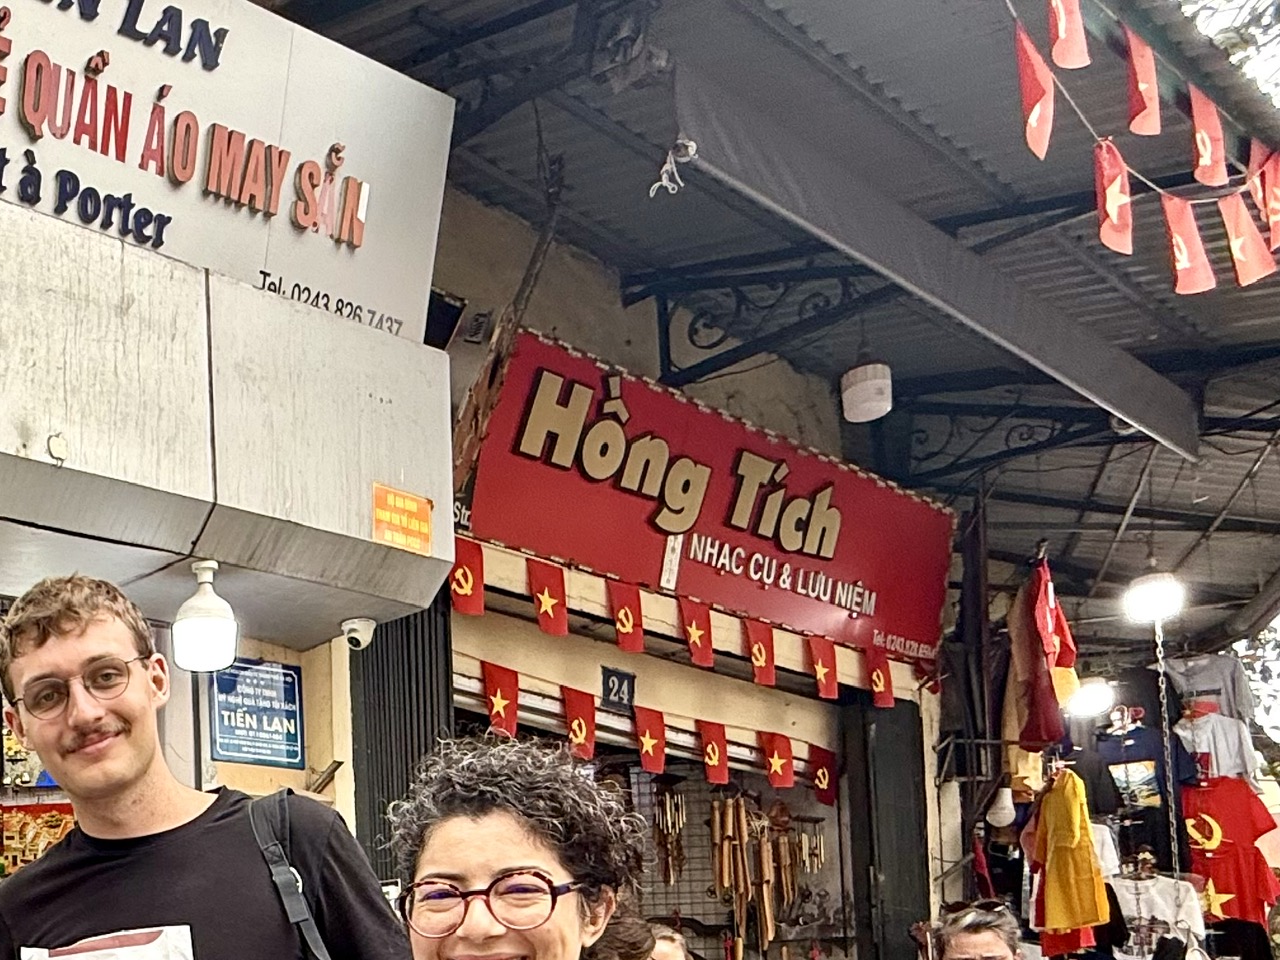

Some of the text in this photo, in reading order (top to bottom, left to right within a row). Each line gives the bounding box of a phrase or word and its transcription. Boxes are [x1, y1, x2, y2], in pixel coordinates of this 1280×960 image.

[117, 0, 229, 72] LAN
[139, 84, 199, 184] ÁO
[203, 122, 291, 217] MAY
[18, 148, 42, 206] à
[53, 169, 172, 250] Porter
[519, 375, 842, 559] Hồng Tích
[689, 533, 745, 575] NHẠC
[749, 552, 777, 591] CỤ
[779, 562, 792, 590] &
[835, 580, 878, 618] NIỆM
[221, 707, 258, 729] TIẾN
[263, 715, 295, 735] LAN
[609, 675, 629, 704] 24
